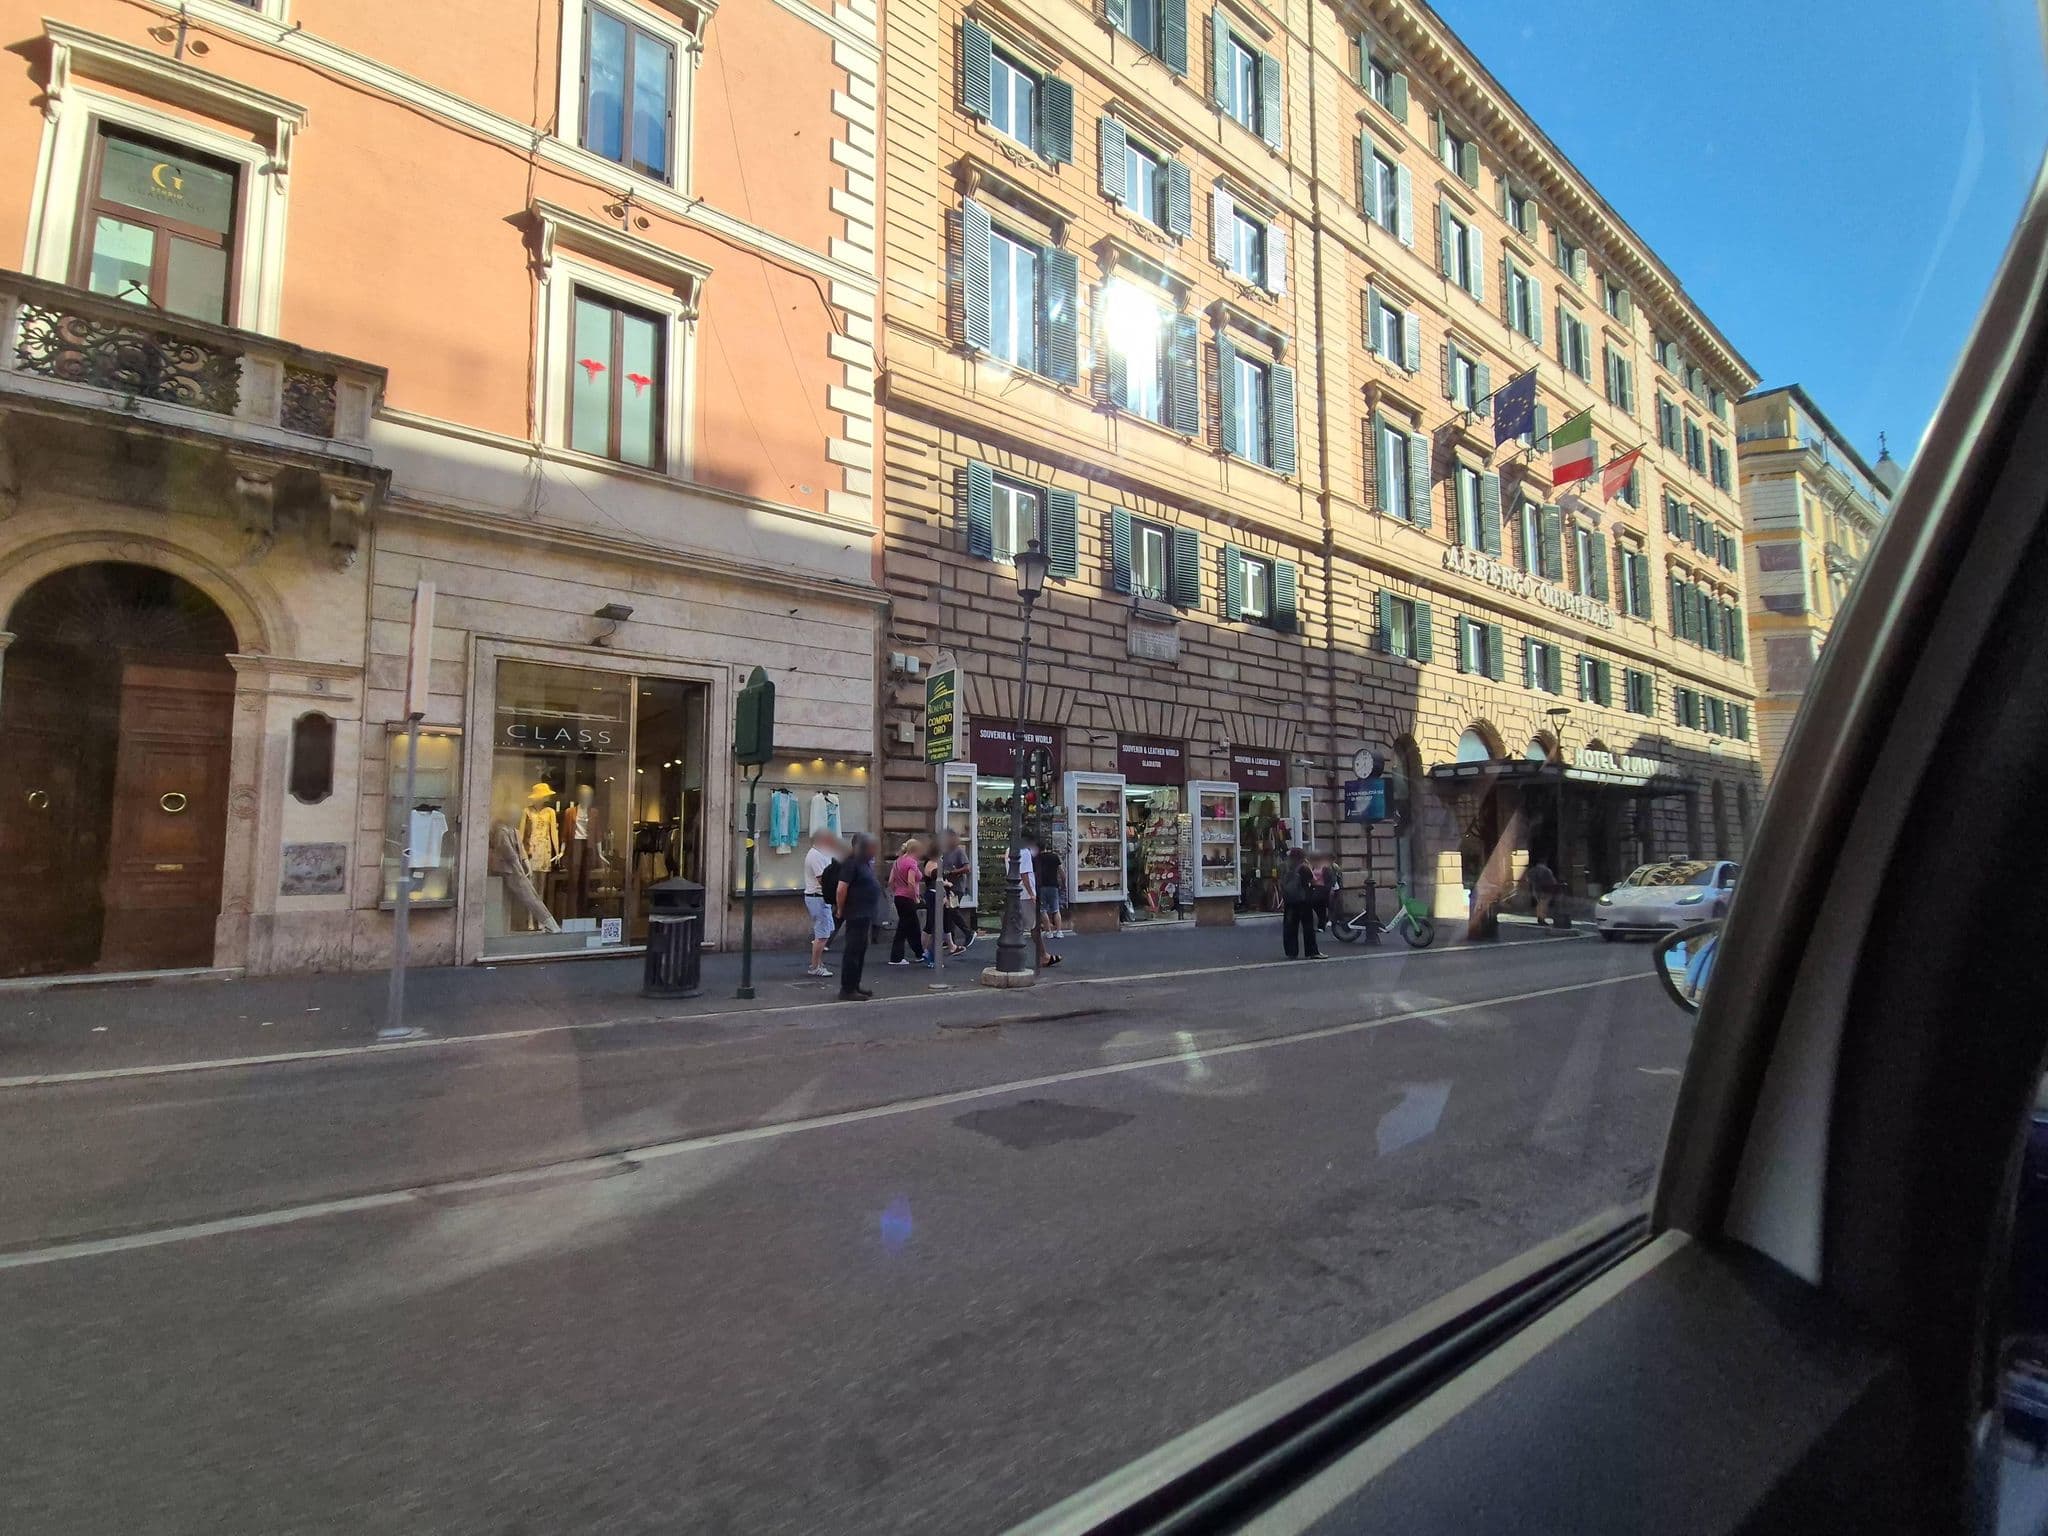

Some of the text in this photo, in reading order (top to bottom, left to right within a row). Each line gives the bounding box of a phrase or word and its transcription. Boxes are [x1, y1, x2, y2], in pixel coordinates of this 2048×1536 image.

[927, 712, 953, 727] COMPRO
[506, 724, 612, 744] CLASS
[933, 724, 946, 736] ORO
[980, 729, 1006, 741] SOUVENIR
[1035, 735, 1053, 744] WORLD
[1574, 747, 1618, 770] HOTEL
